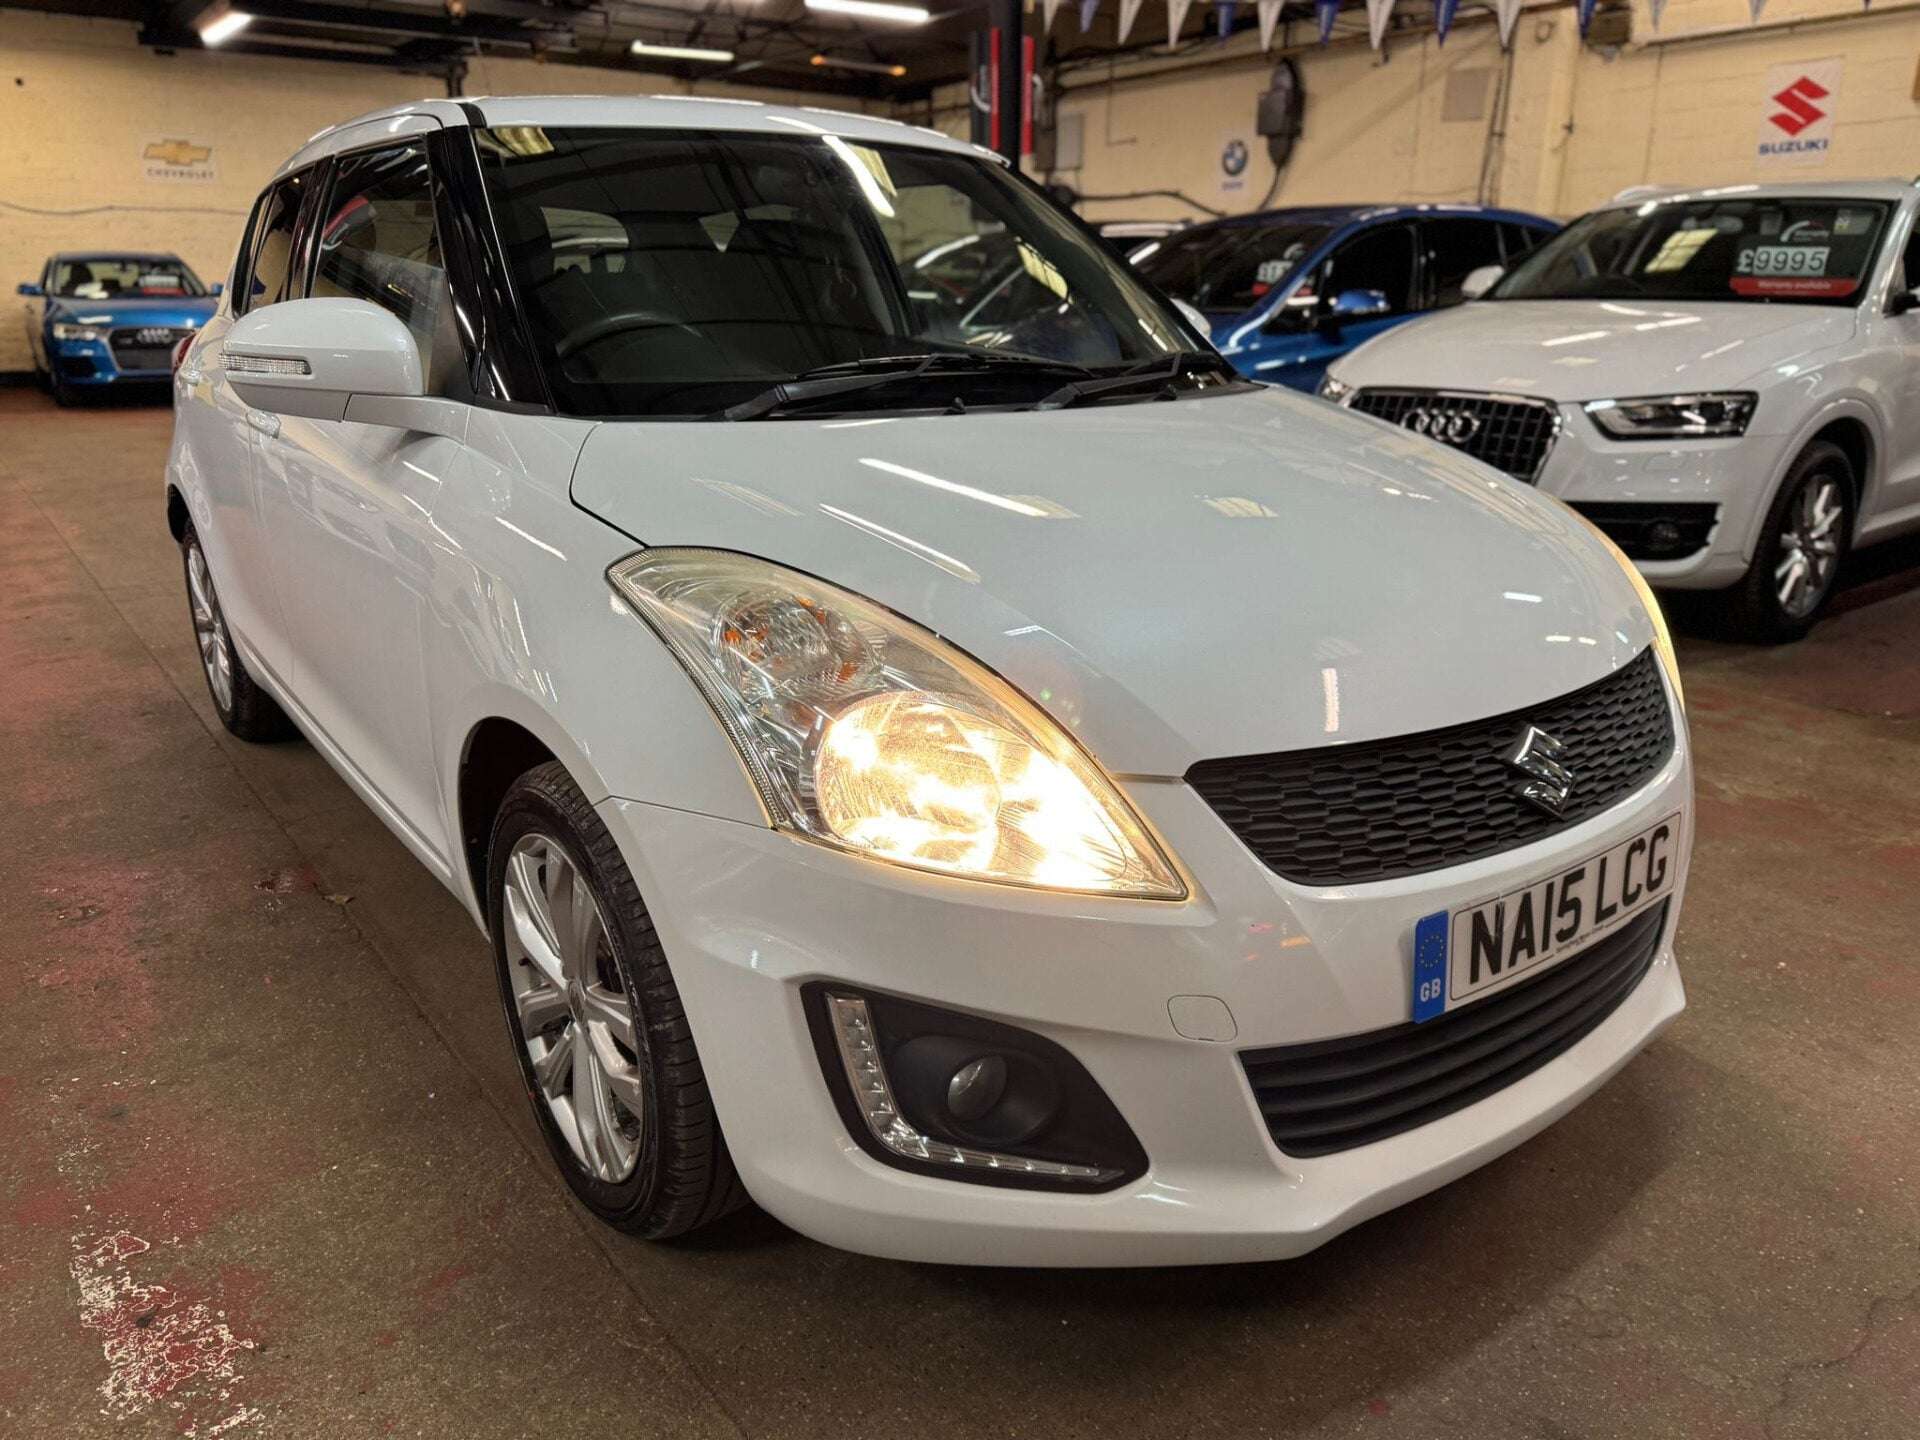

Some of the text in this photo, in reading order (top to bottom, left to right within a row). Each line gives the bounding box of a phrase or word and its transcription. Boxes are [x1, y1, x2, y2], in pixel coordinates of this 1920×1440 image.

[1758, 139, 1829, 155] SUZUKI
[146, 167, 215, 179] CHEVROLET
[1736, 250, 1826, 273] £9995
[1469, 824, 1670, 986] NA15 LCG
[1419, 977, 1442, 1002] GB
